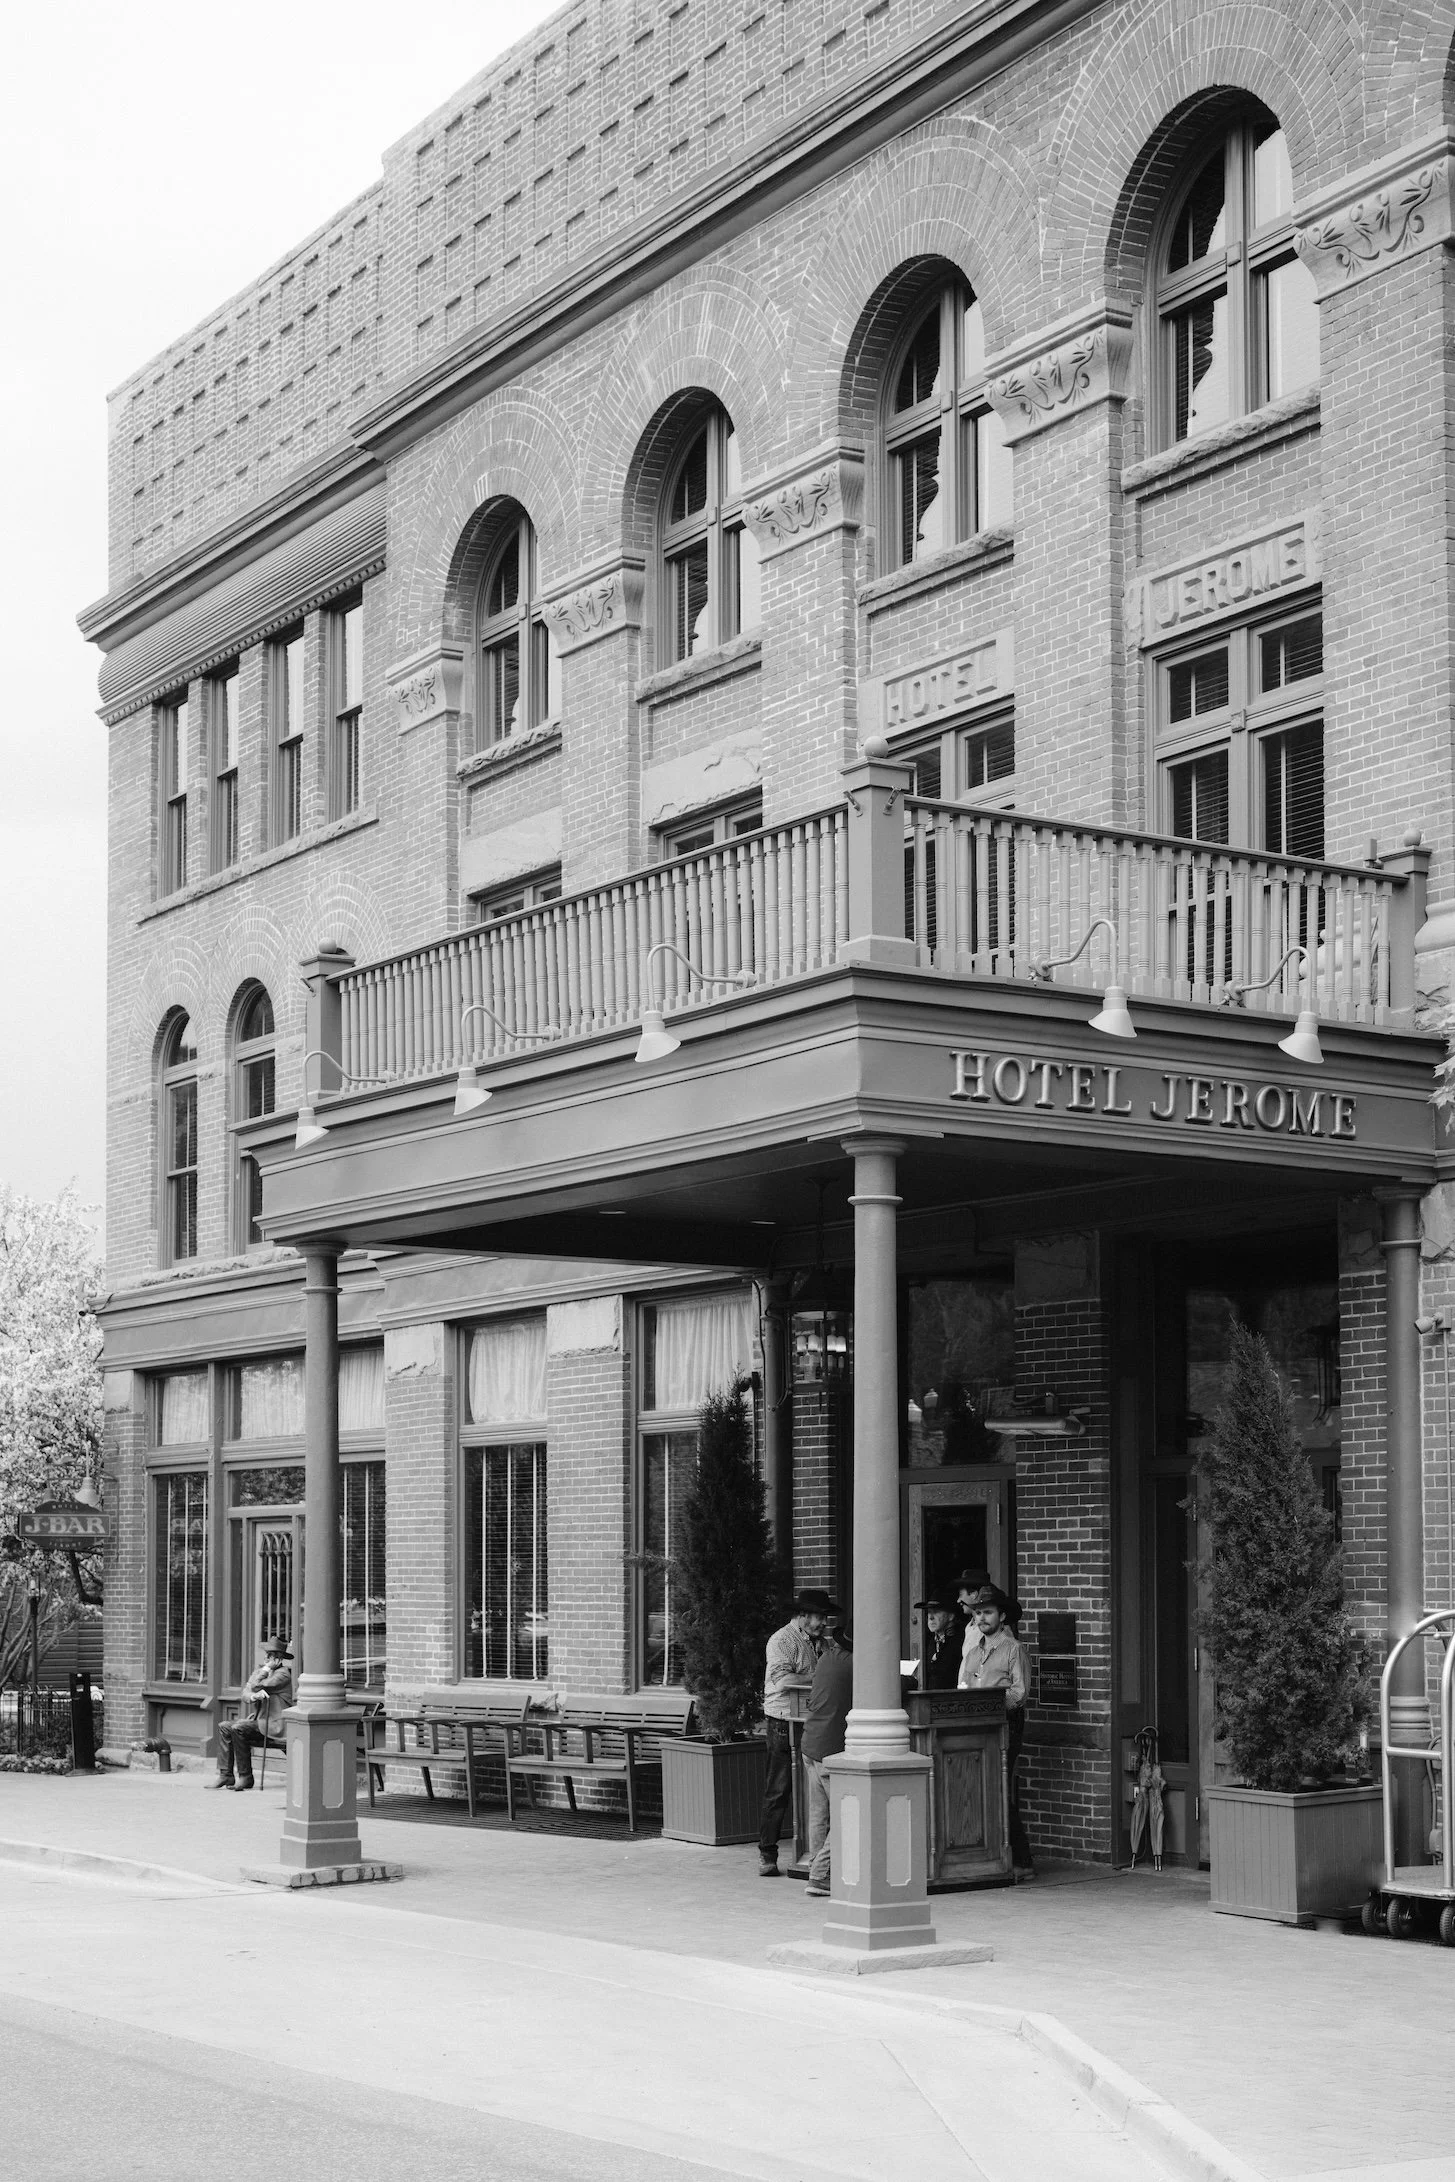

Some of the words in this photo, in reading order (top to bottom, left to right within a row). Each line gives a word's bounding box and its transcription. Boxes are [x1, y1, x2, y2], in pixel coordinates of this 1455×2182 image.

[1154, 529, 1306, 630] JEROME
[887, 651, 998, 728] HOTEL
[950, 1050, 1132, 1117] HOTEL
[1150, 1073, 1357, 1140] JEROME
